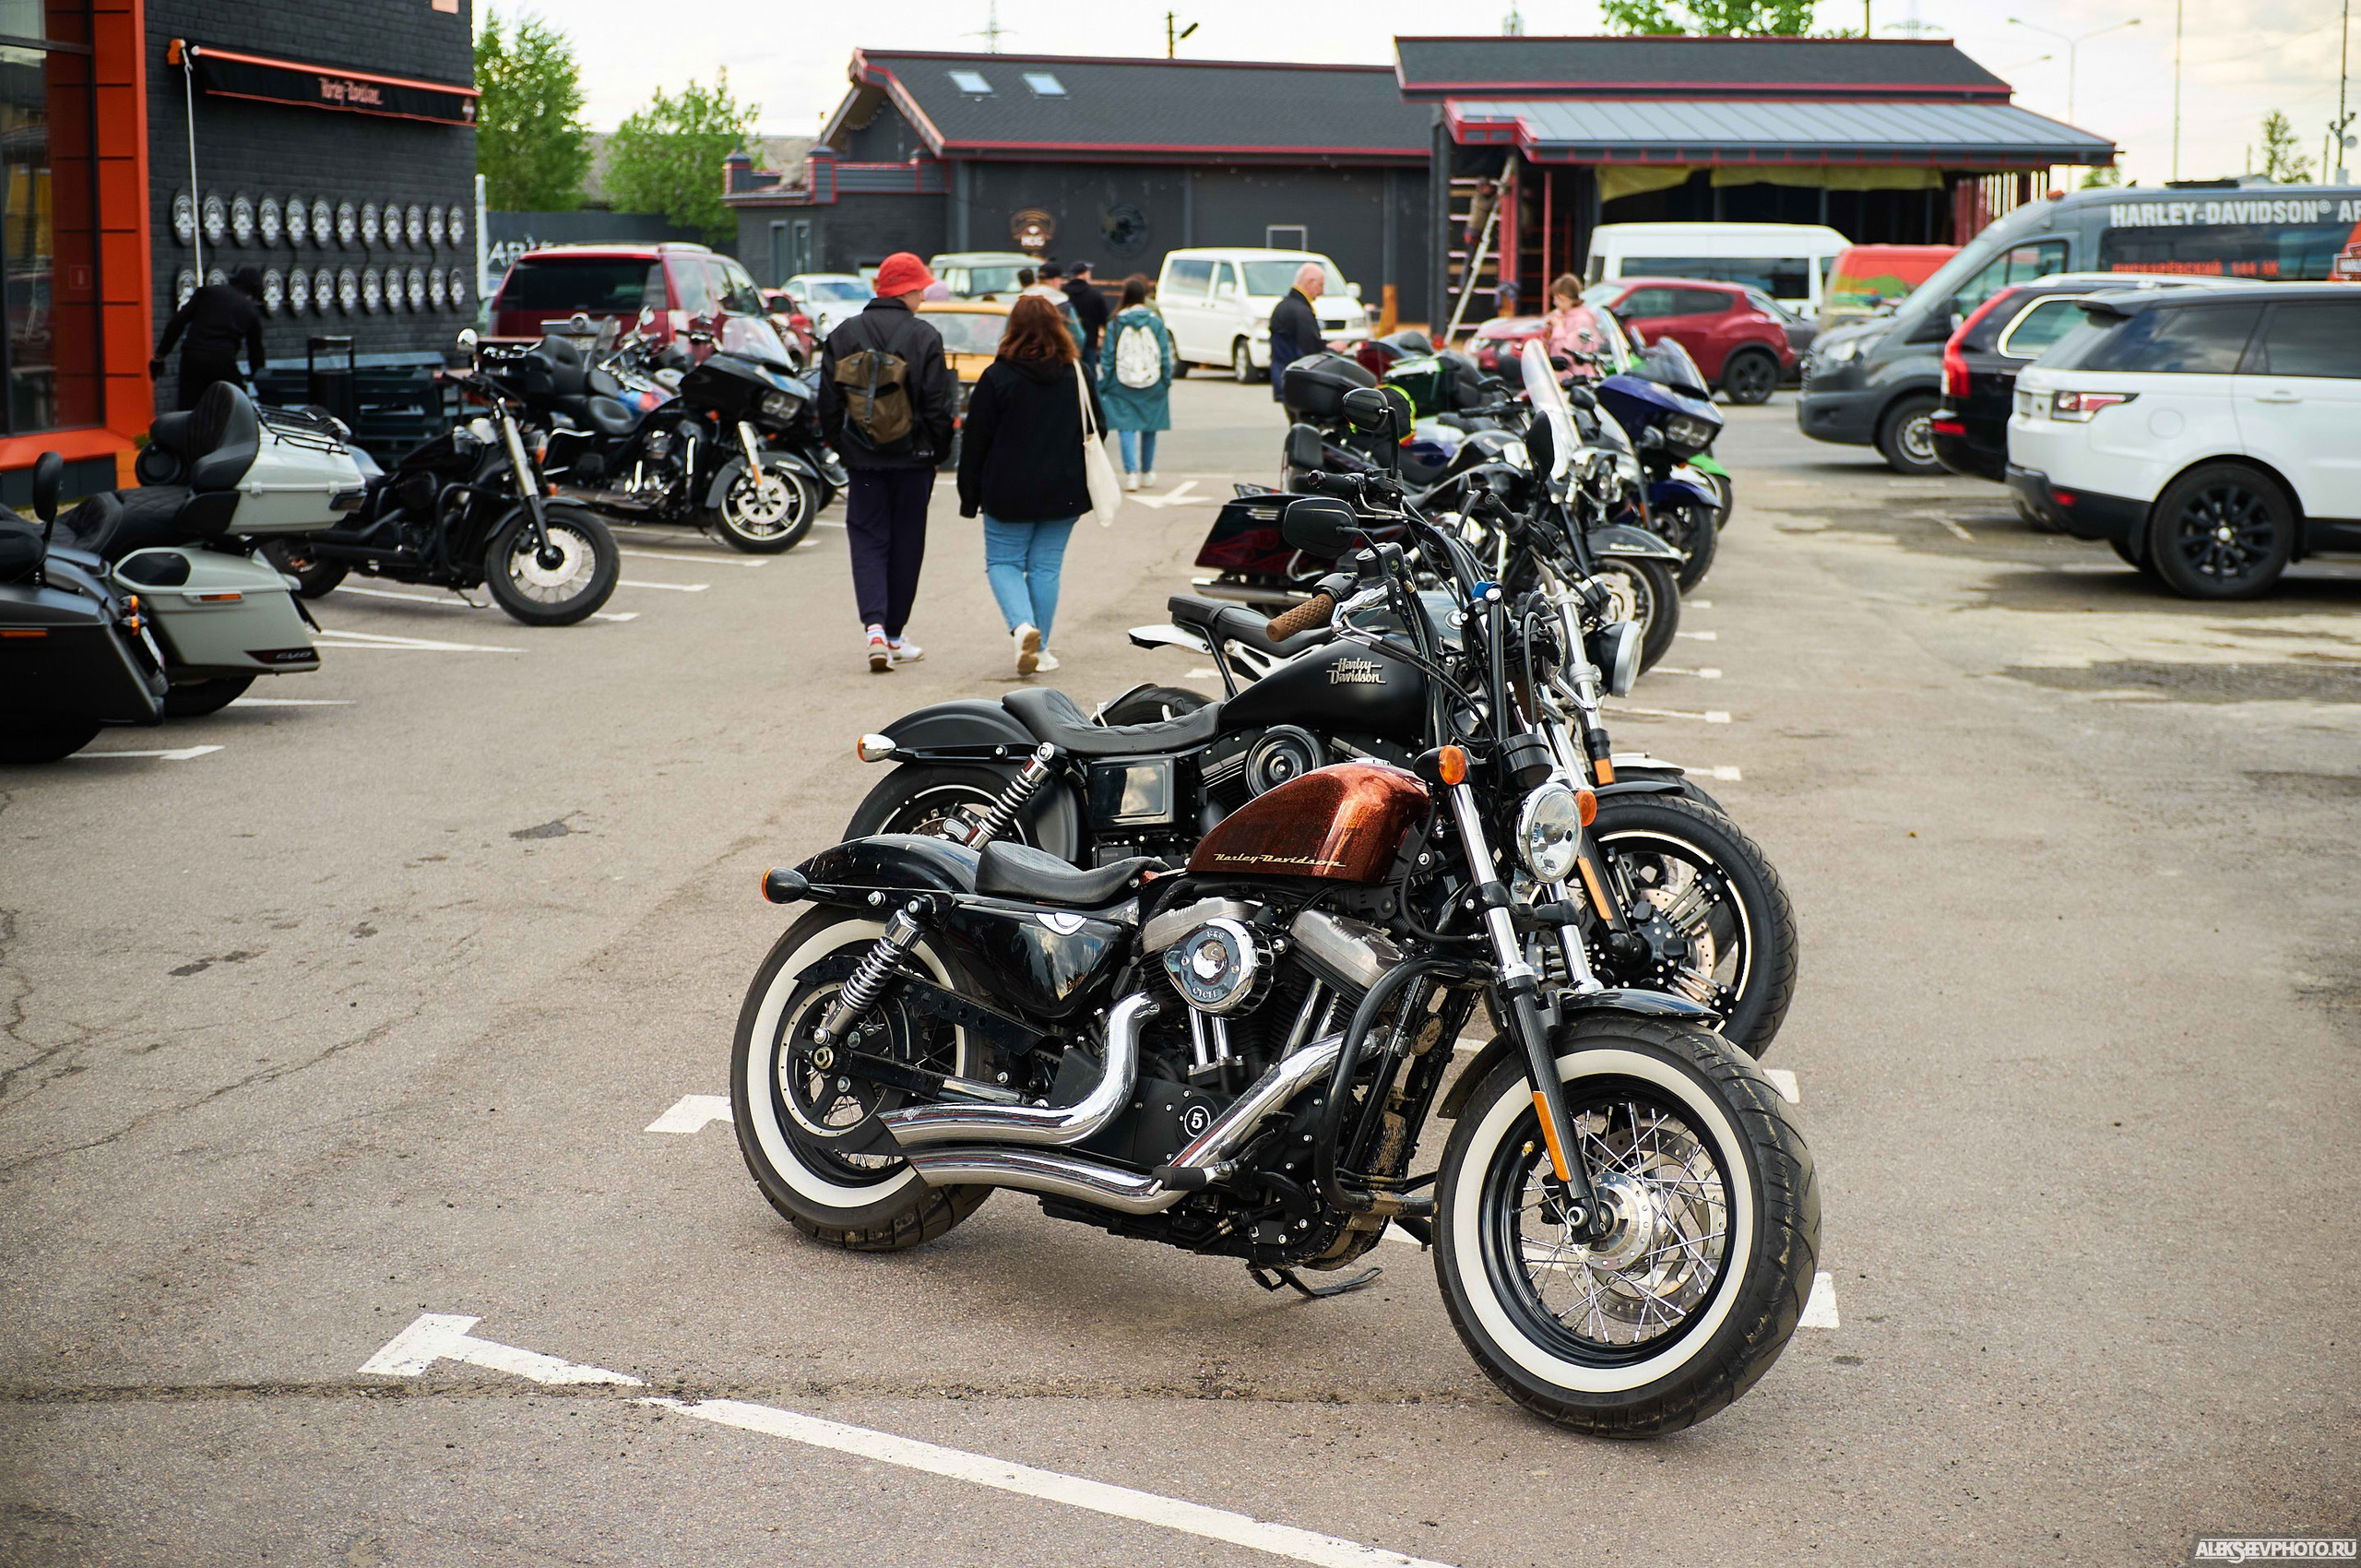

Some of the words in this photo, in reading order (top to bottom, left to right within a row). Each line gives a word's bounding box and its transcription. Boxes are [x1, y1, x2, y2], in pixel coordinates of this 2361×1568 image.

[1326, 670, 1386, 684] Davidson
[1214, 853, 1347, 868] Harley-Davidson
[1192, 986, 1218, 999] CYCLE
[1191, 1111, 1204, 1129] 5
